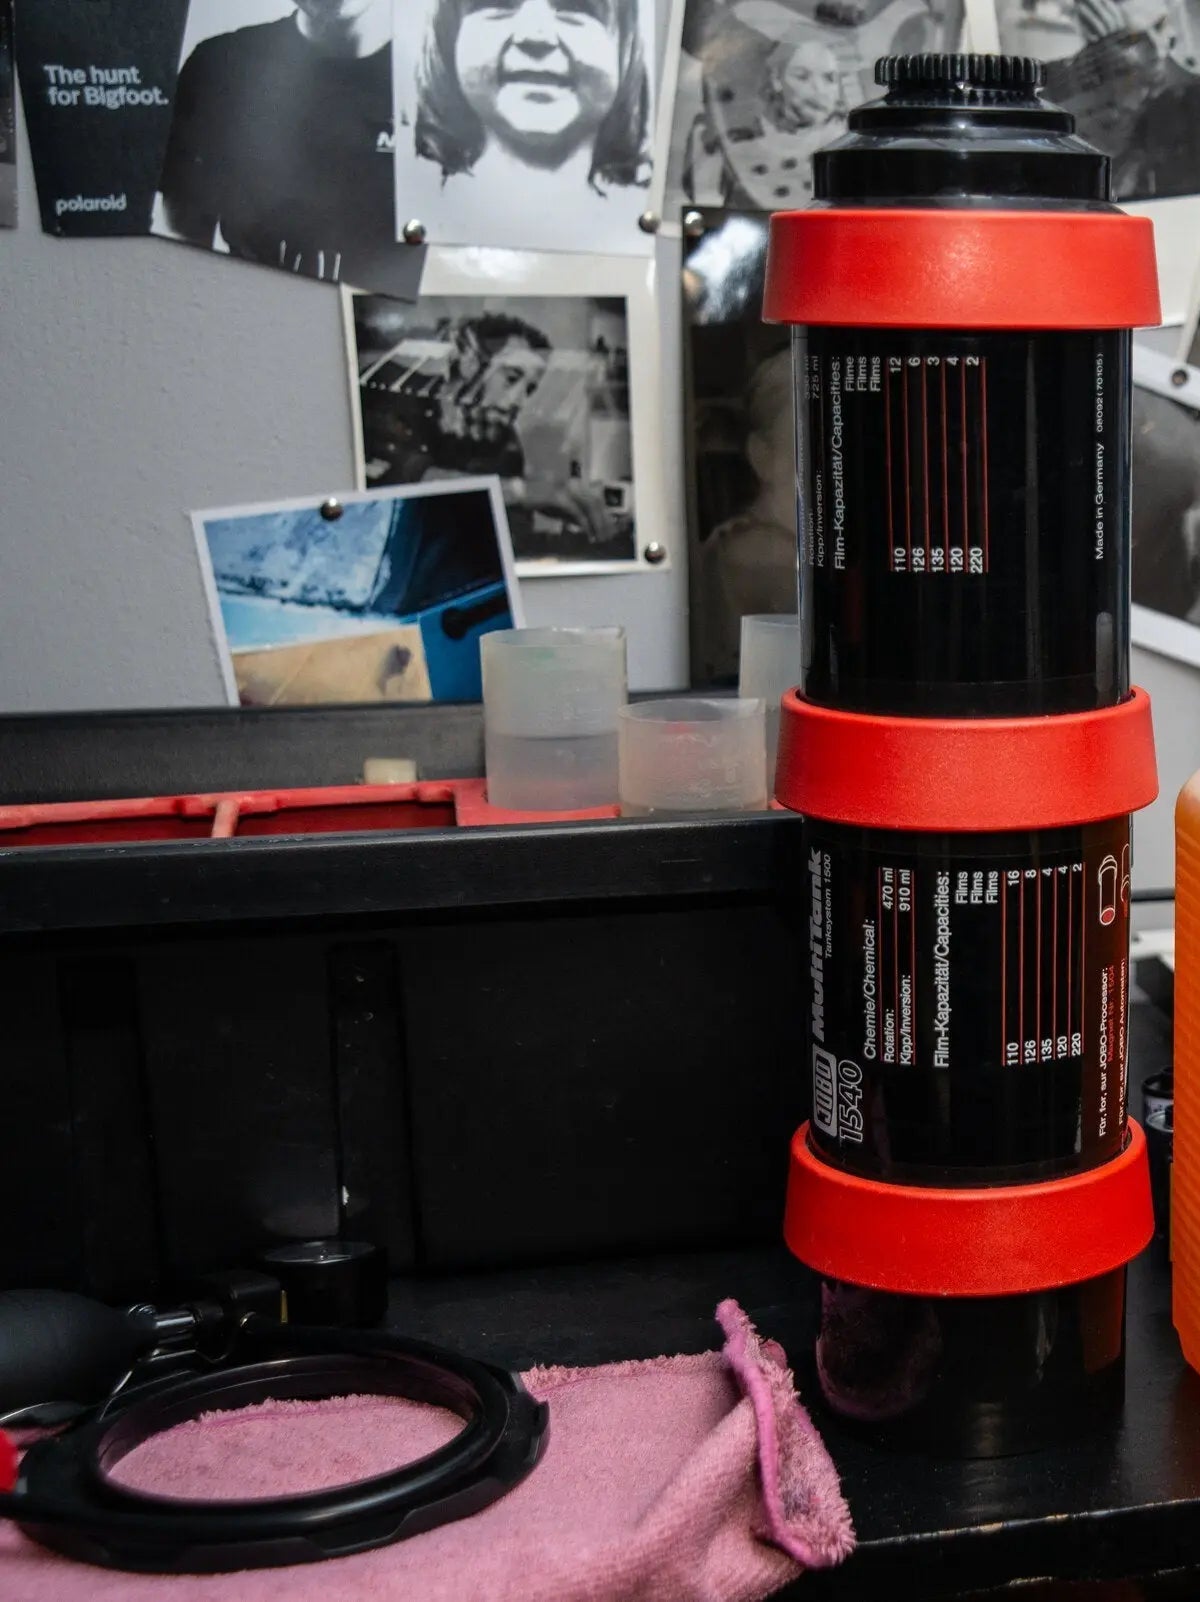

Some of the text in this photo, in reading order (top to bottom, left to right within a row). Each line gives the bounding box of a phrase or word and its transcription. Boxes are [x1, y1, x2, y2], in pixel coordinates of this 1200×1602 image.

[43, 65, 141, 84] The hunt
[49, 86, 169, 110] for Bigfoot.
[56, 193, 127, 216] polaroid
[810, 355, 825, 567] Kipp/Inversion: 725 ml
[830, 356, 846, 570] Film-Kapazität/Capacities:
[845, 356, 855, 392] Filme
[857, 356, 867, 391] Films
[870, 356, 881, 391] Films
[928, 356, 944, 572] 135 3
[889, 358, 907, 572] 110 12
[908, 358, 925, 572] 126 6
[946, 357, 963, 572] 120 4
[966, 356, 983, 574] 220 2
[1095, 443, 1106, 504] Germany
[1095, 507, 1105, 519] in
[1095, 521, 1105, 559] Made
[823, 853, 833, 958] Tanksystem 1500
[882, 867, 895, 1063] Rotation: 470 ml
[899, 869, 912, 1065] Kipp/Inversion: 910 ml
[934, 870, 951, 1067] Film-Kapazität/Capacities:
[955, 871, 969, 904] Films
[971, 871, 984, 904] Films
[986, 871, 999, 904] Films
[1007, 870, 1020, 1066] 110 16
[1024, 869, 1037, 1064] 126 8
[1041, 868, 1053, 1061] 135 4
[1057, 866, 1068, 1059] 120 4
[1071, 863, 1083, 1056] 220 2
[808, 846, 836, 1129] JOBO MultiTank
[863, 918, 876, 1059] Chemie/Chemical:
[1098, 967, 1109, 1136] Für, for, sur JOBO-Processor:
[838, 1060, 863, 1143] 1540
